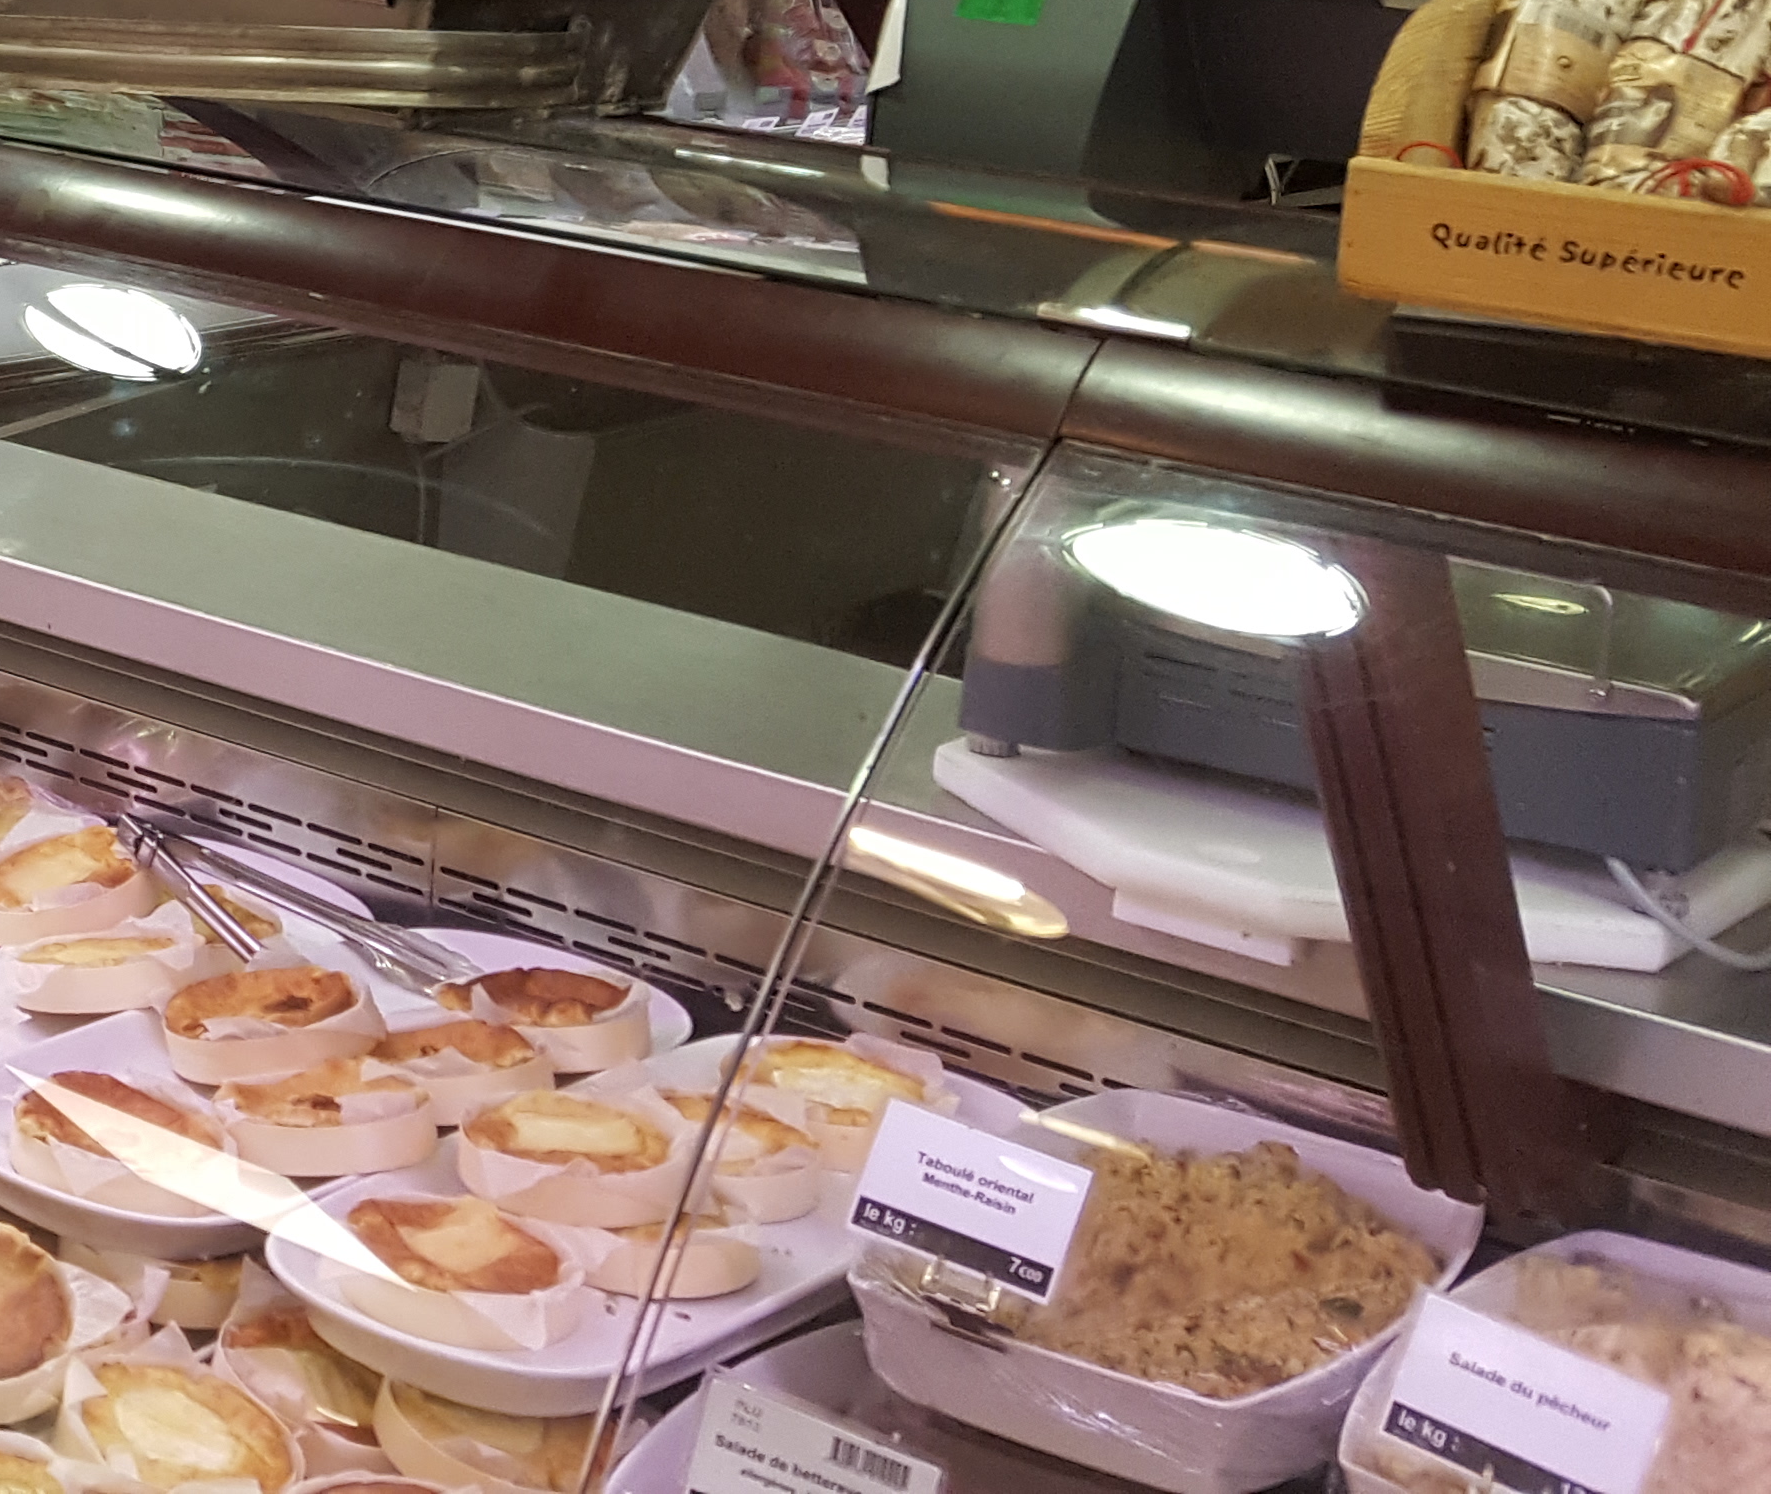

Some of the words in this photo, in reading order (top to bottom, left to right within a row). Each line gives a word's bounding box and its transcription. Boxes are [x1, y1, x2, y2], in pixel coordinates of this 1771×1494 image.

[1431, 222, 1549, 262] Qualité
[1559, 240, 1746, 290] Supérieure
[917, 1150, 975, 1186] Taboulé
[977, 1170, 1035, 1204] oriental
[921, 1171, 1017, 1215] Menthe-Raisin
[863, 1202, 881, 1222] le
[882, 1211, 907, 1236] kg
[1447, 1351, 1507, 1388] Salade
[1509, 1379, 1535, 1401] du
[1536, 1391, 1612, 1434] pêcheur
[714, 1433, 767, 1463] Salade
[769, 1455, 789, 1472] de
[1396, 1410, 1418, 1431] le
[1421, 1419, 1448, 1453] kg
